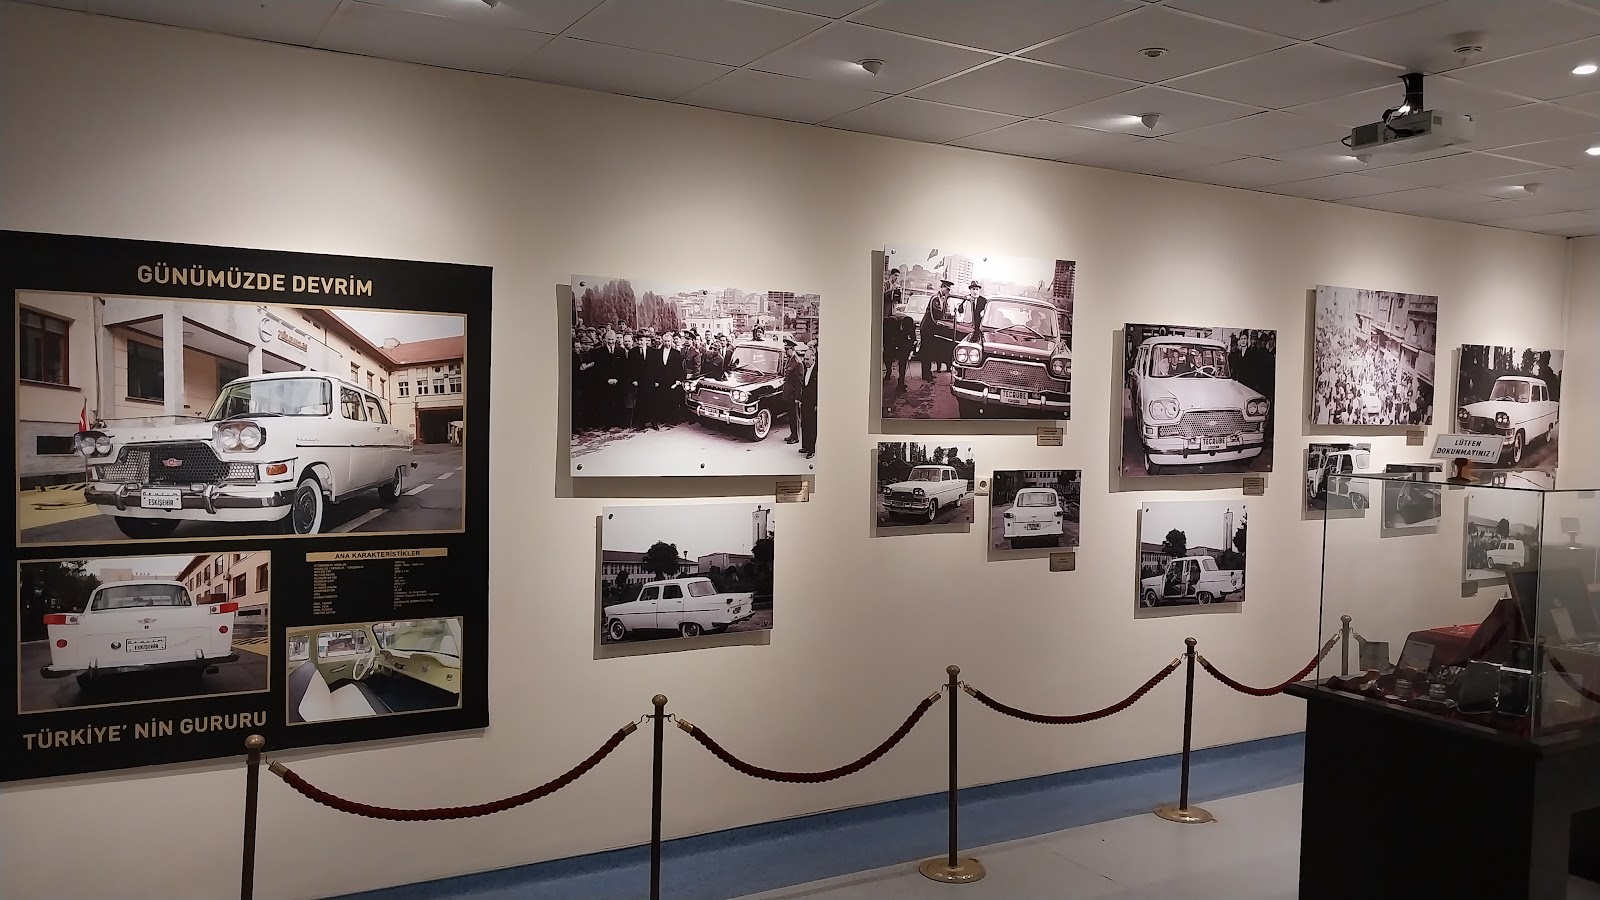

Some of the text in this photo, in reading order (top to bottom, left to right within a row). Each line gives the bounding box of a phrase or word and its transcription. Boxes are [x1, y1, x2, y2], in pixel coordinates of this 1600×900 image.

[137, 262, 373, 297] GÜNÜMÜZDE DEVRİM
[1454, 438, 1482, 447] LÜTFEN
[351, 549, 421, 559] KARAKTERİSTİKLER
[134, 717, 173, 740] NİN
[179, 710, 267, 735] GURURU
